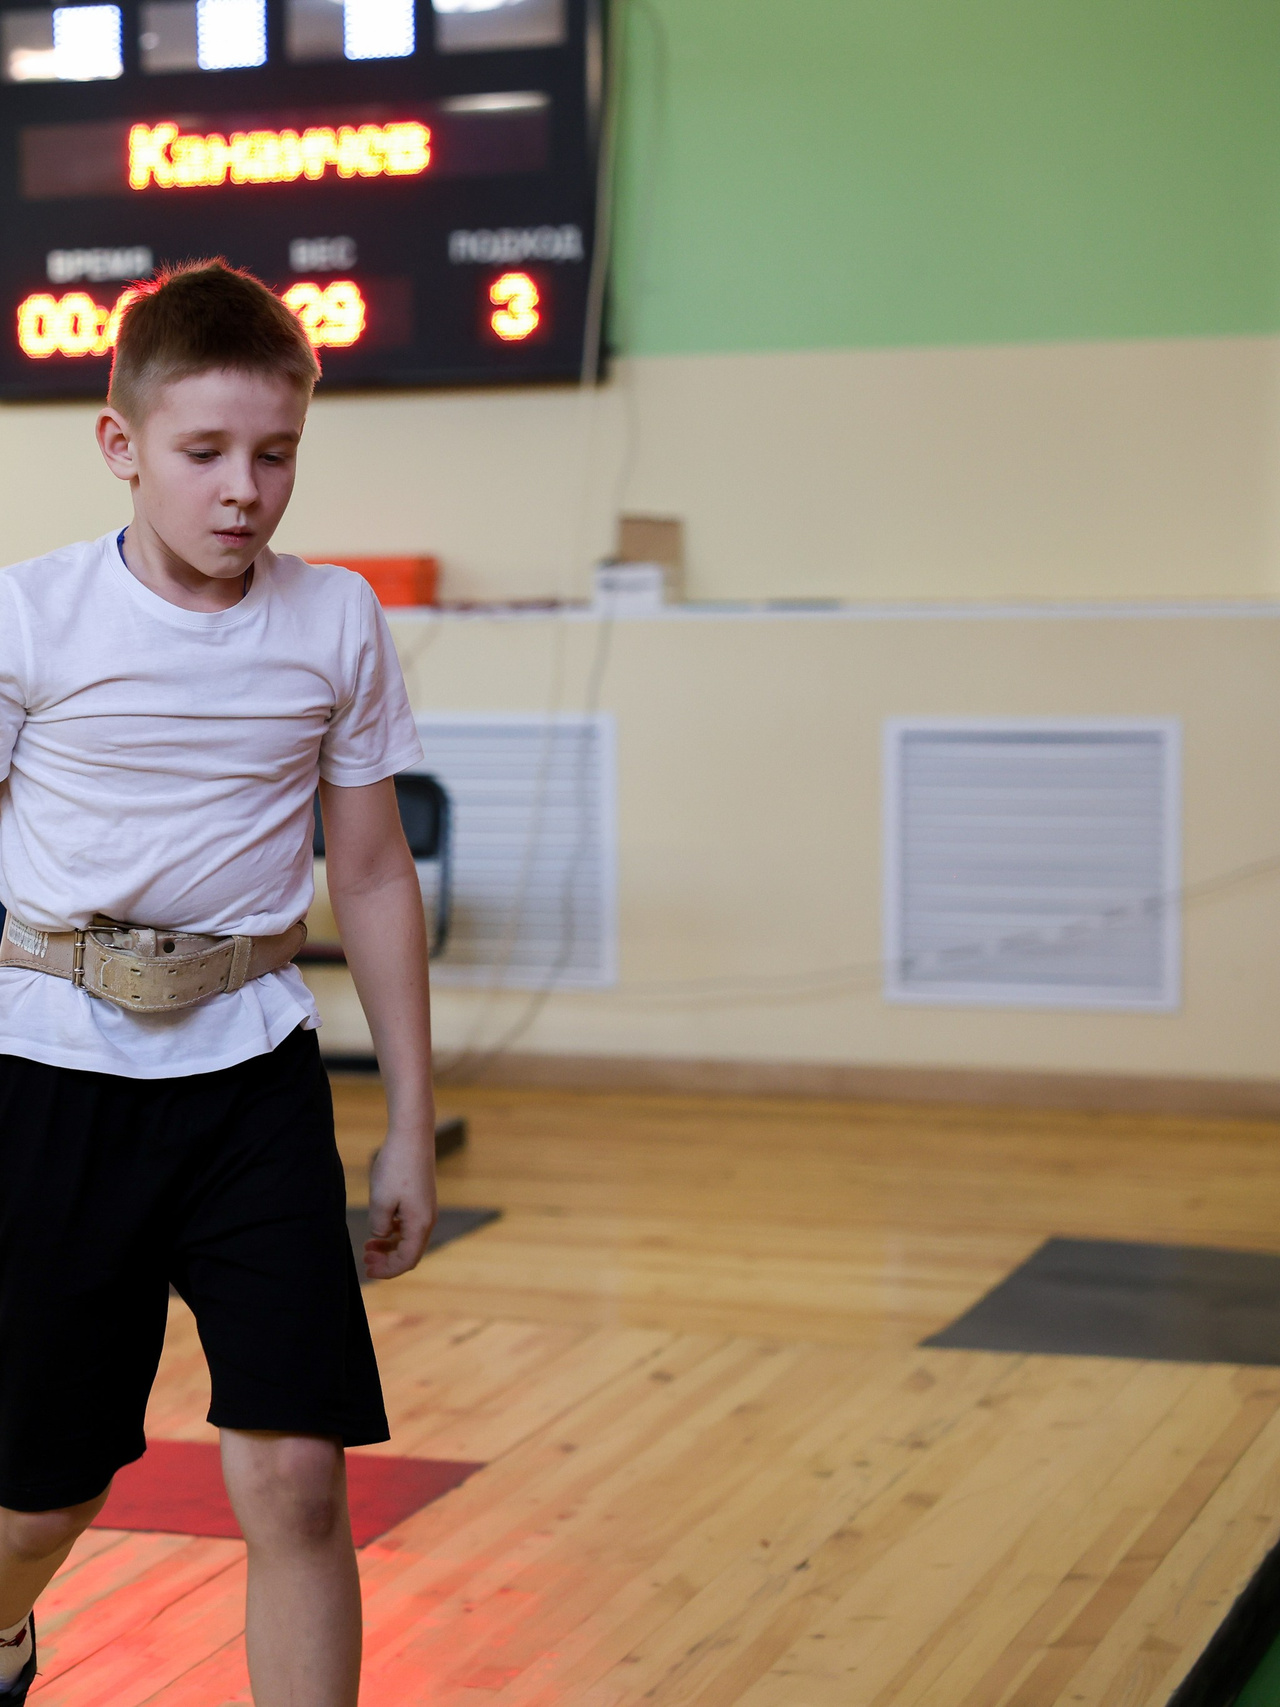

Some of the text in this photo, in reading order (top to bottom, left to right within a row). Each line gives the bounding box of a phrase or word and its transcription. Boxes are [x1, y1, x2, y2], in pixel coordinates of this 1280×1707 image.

[288, 236, 357, 272] ВЕС
[448, 225, 583, 264] ПОДХОД
[489, 273, 540, 341] 3
